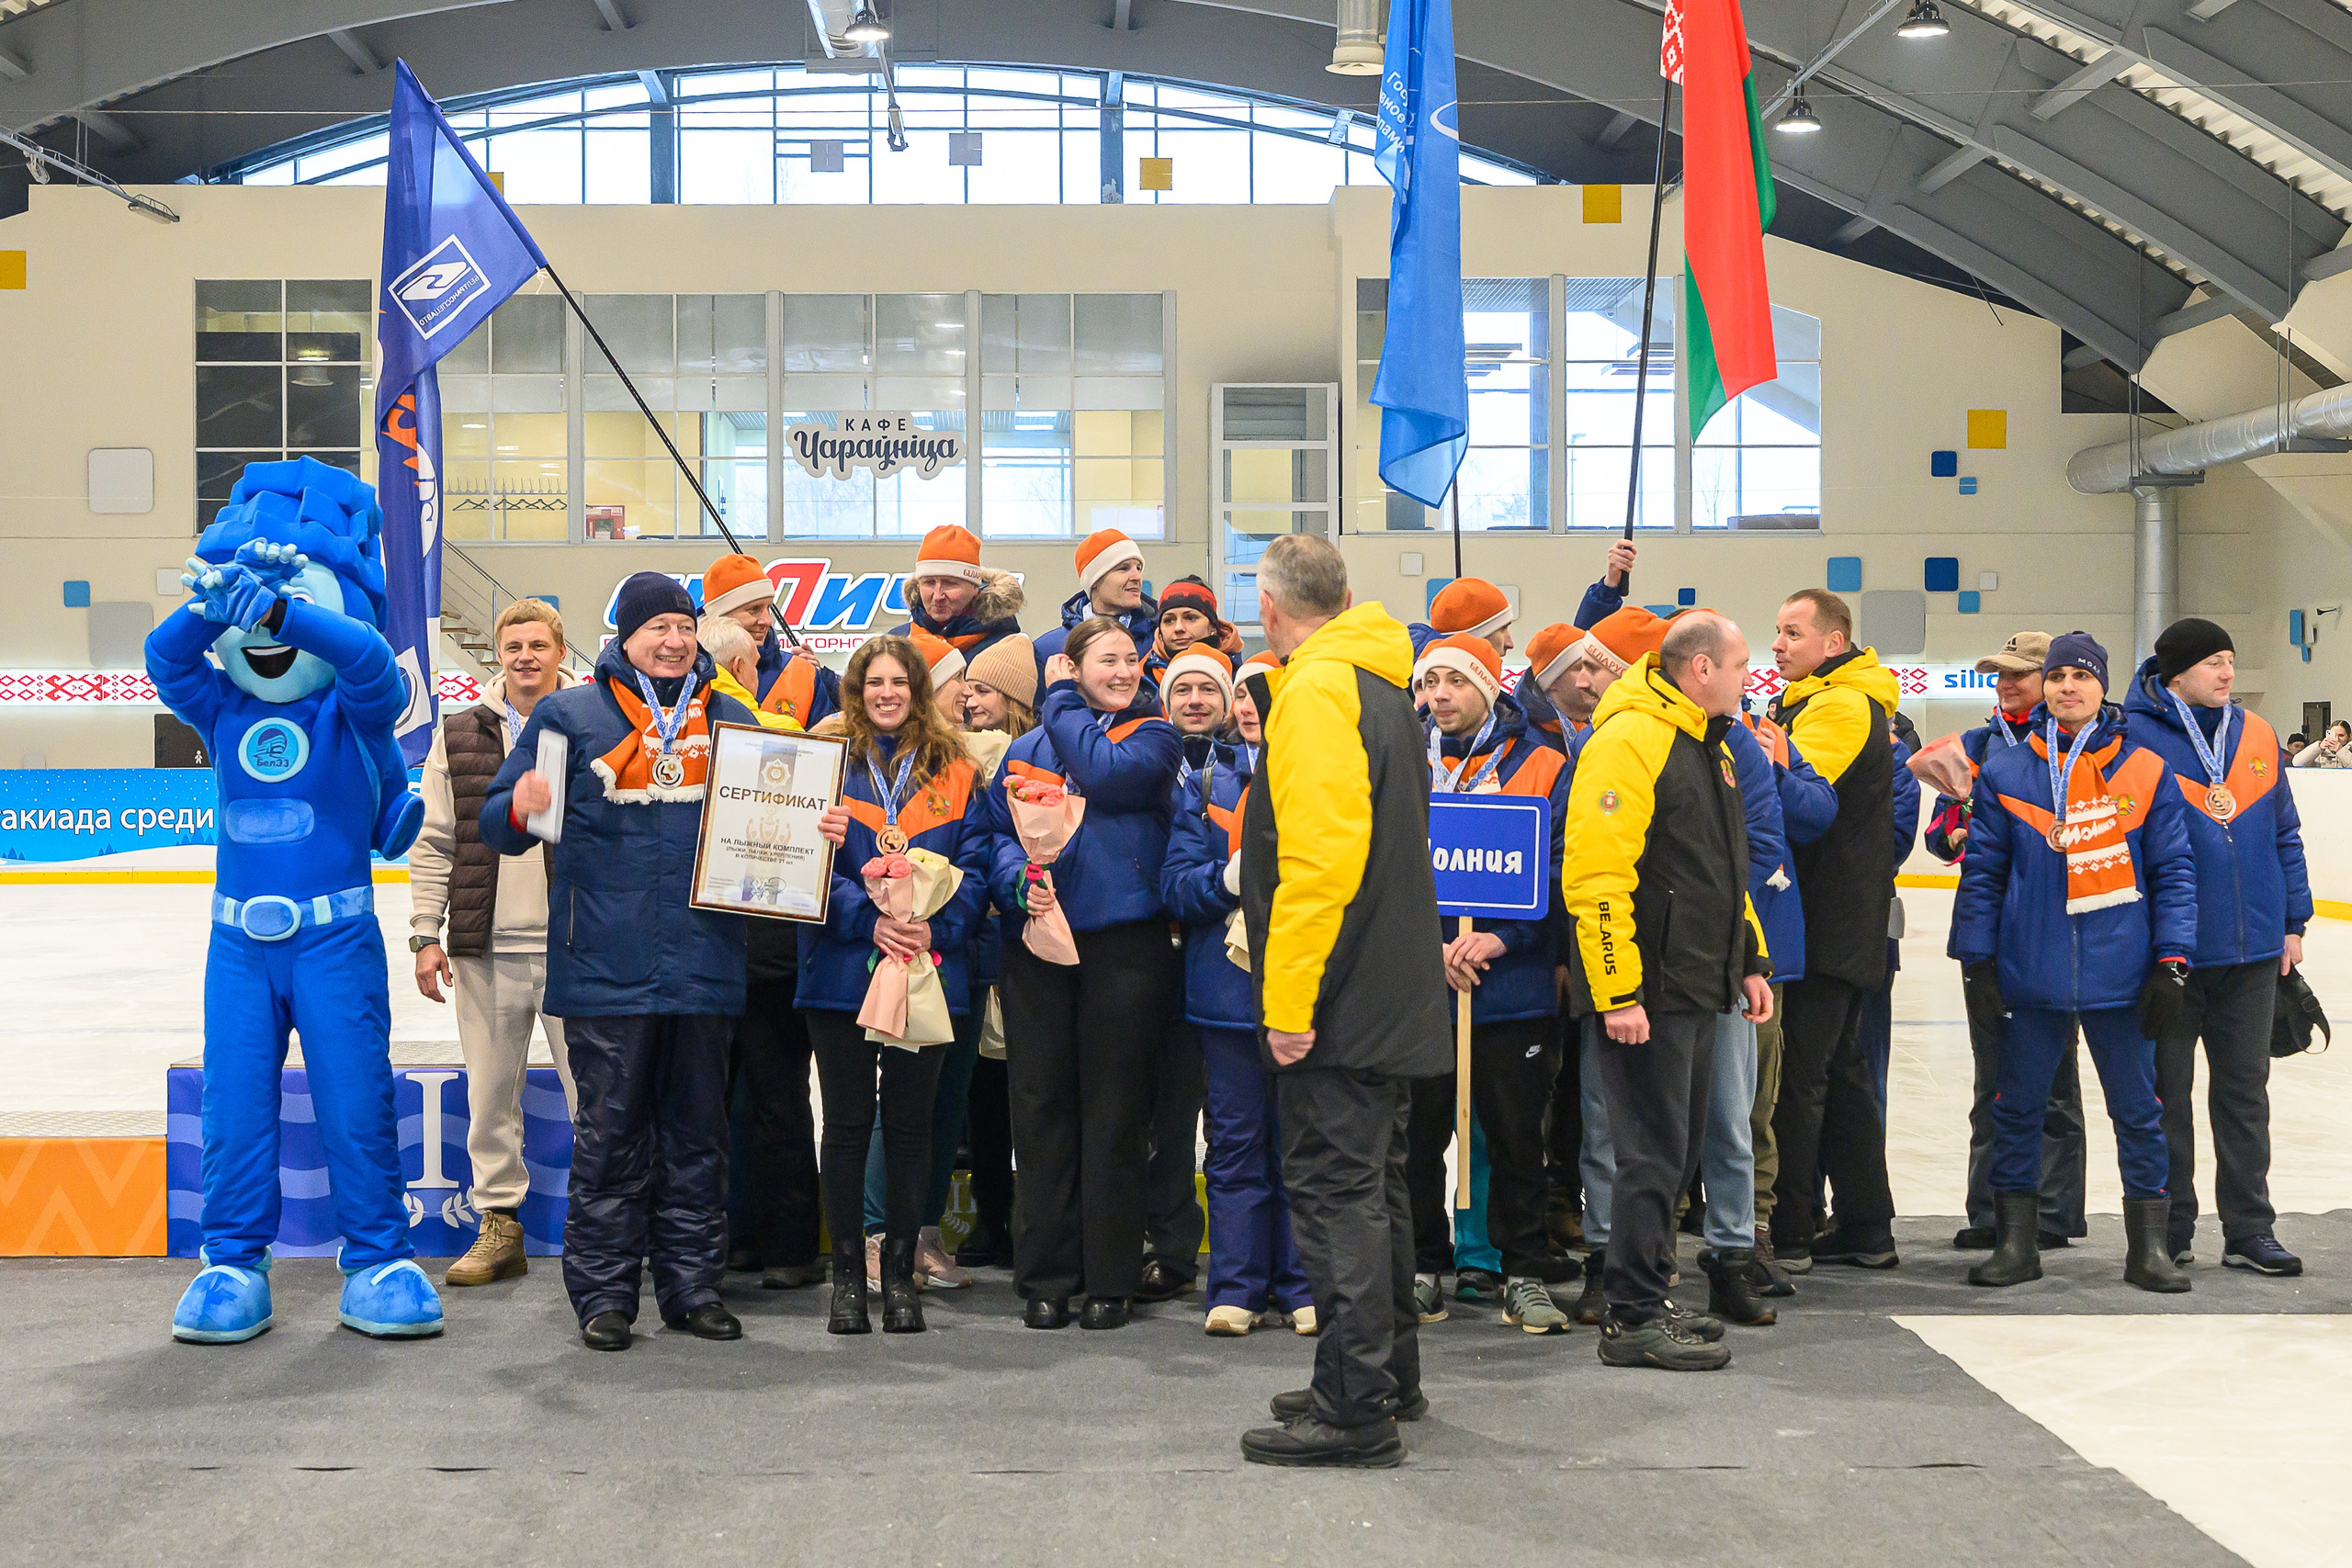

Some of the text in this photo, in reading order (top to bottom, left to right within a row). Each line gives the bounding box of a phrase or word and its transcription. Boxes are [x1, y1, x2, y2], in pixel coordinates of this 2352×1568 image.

[845, 418, 906, 432] КАФЕ
[793, 430, 959, 473] Чараўніца
[1944, 669, 2000, 688] silic
[719, 785, 827, 811] СЕРТИФИКАТ
[0, 807, 215, 837] акиада среди
[720, 837, 815, 855] НА ЛЫЖНЫЙ КОМПЛЕКТ
[741, 854, 777, 863] КОЛИЧЕСТВЕ
[1428, 838, 1523, 874] олния
[1599, 901, 1617, 976] BELARUS
